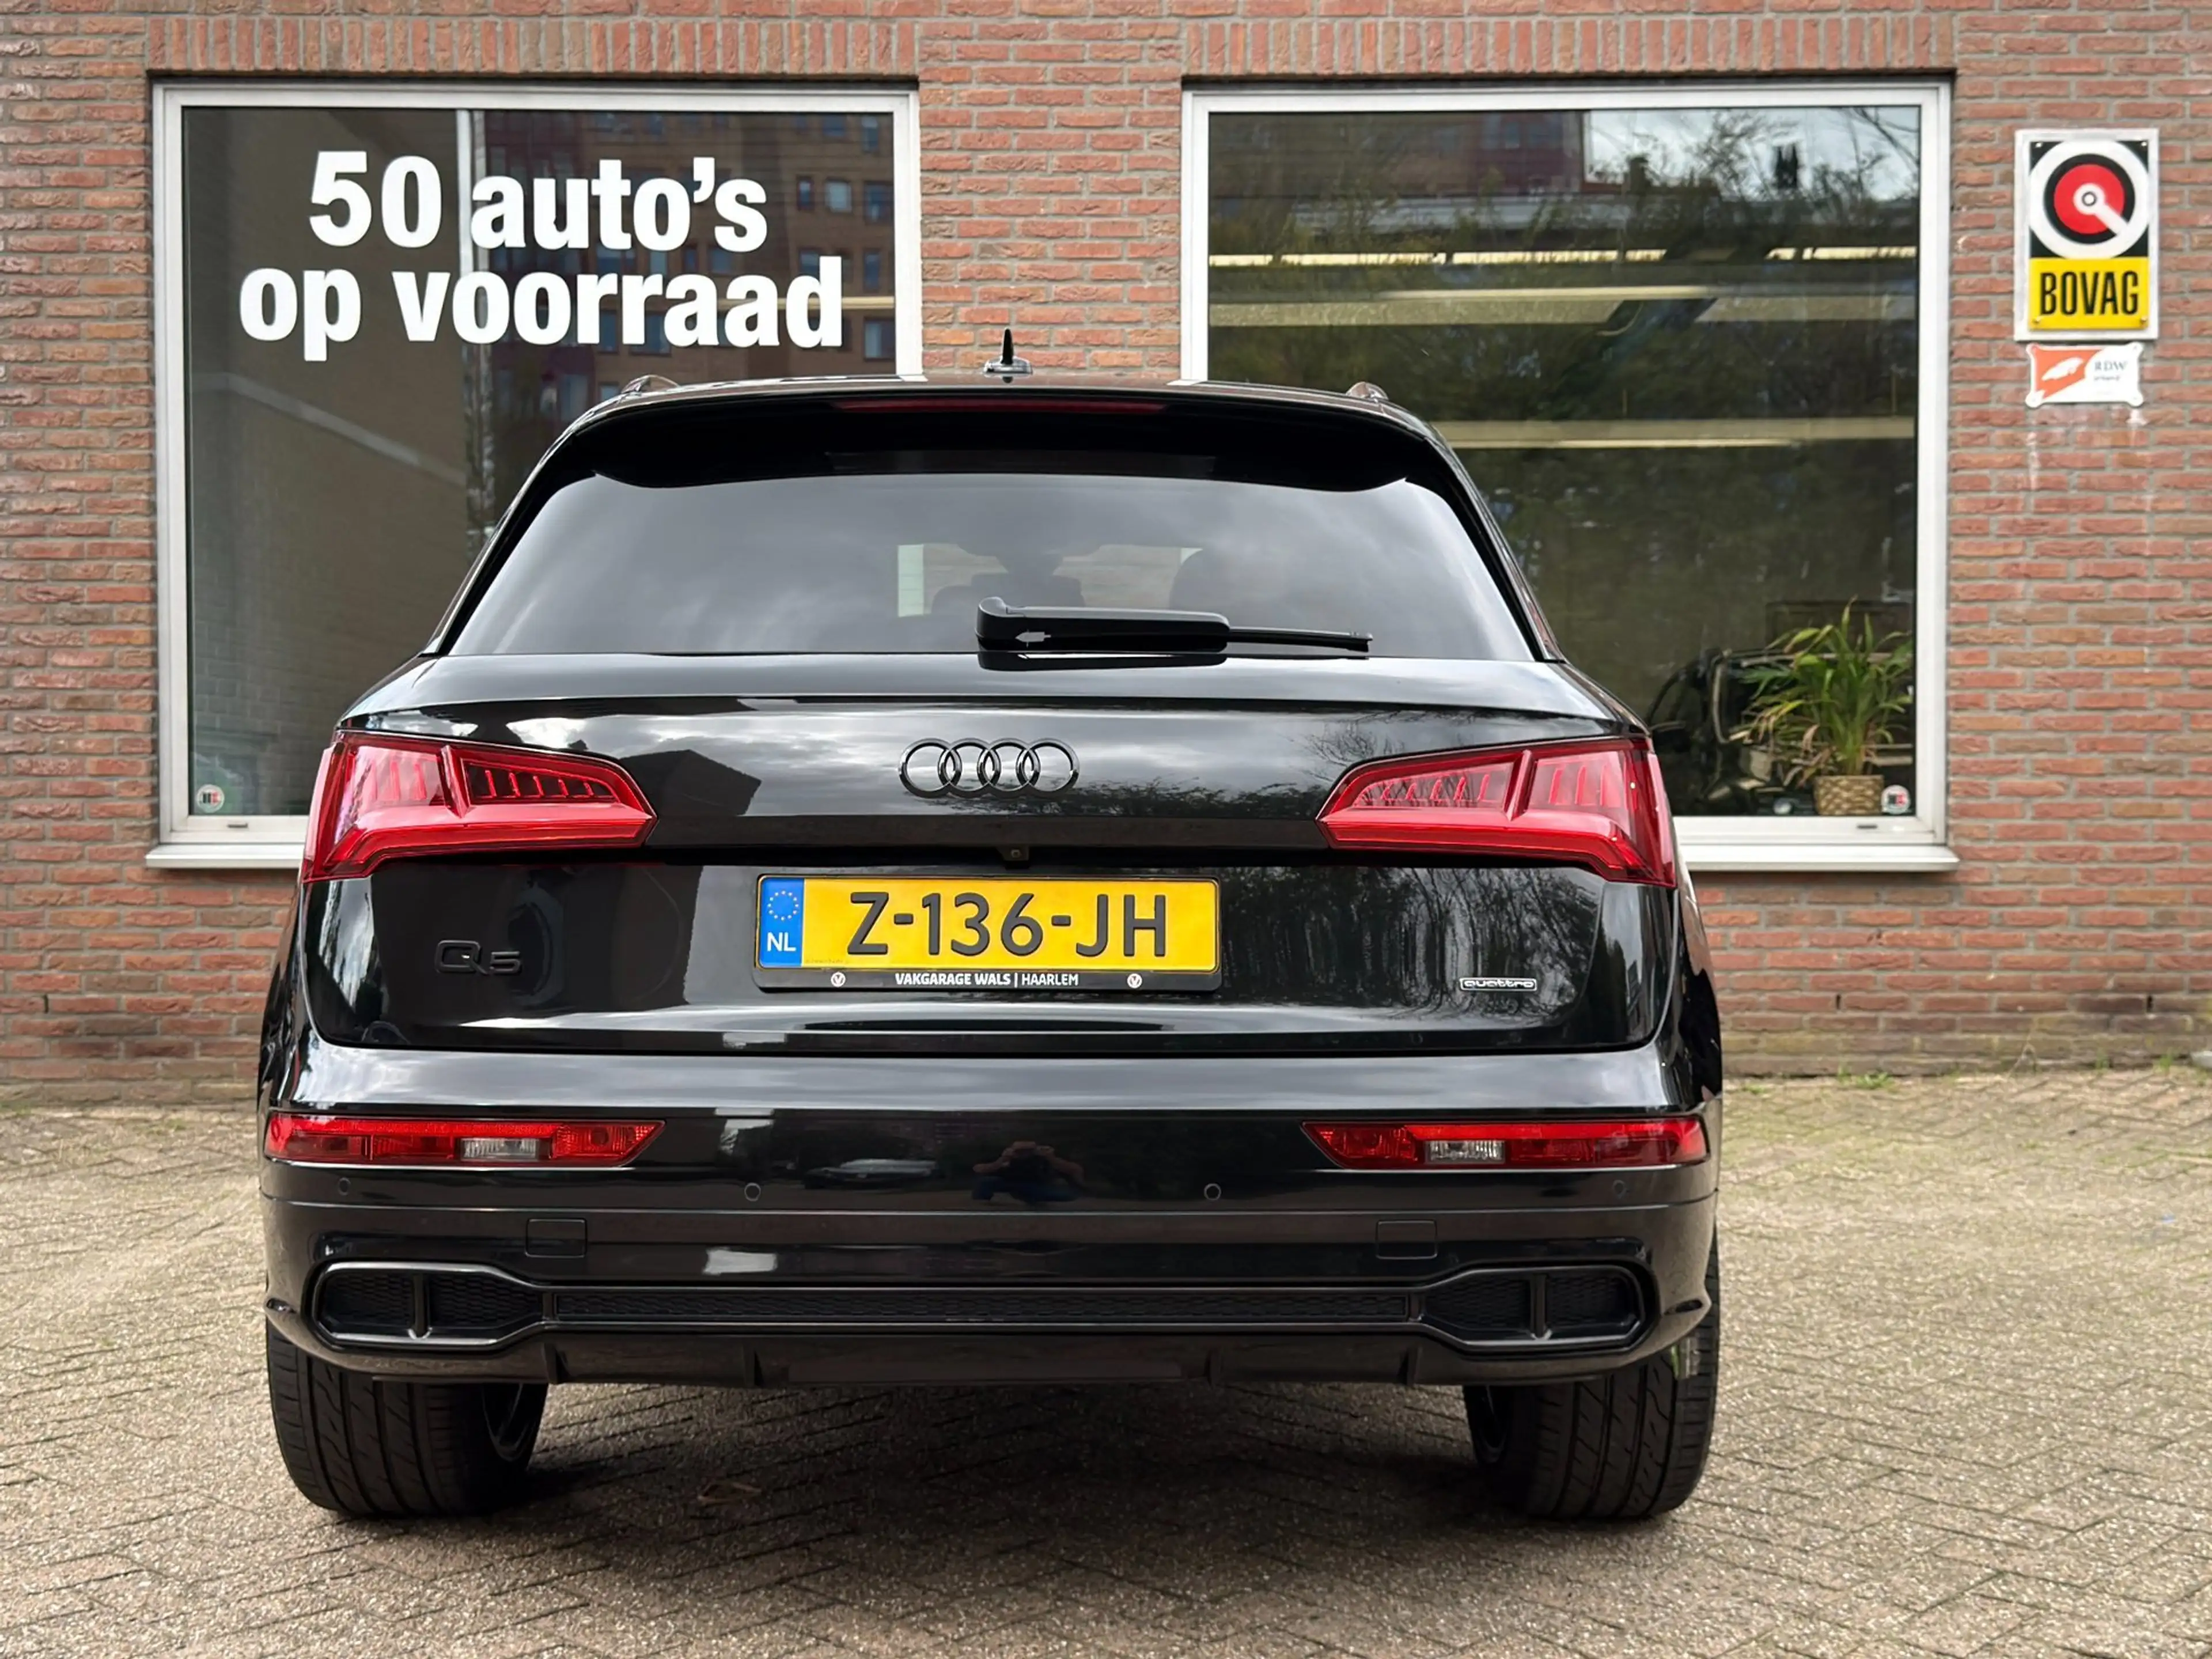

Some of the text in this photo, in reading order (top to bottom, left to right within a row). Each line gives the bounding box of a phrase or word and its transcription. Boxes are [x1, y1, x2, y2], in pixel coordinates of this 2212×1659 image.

[309, 151, 767, 252] 50 auto's
[240, 256, 842, 362] op voorraad
[2040, 270, 2139, 316] BOVAG
[767, 931, 797, 952] NL
[847, 891, 1166, 958] Z-136-JH
[435, 940, 521, 975] Q5
[895, 972, 972, 986] VAKGARAGE
[974, 972, 1011, 986] WALS
[1021, 973, 1078, 986] HAARLEM
[1464, 980, 1534, 988] quattro
